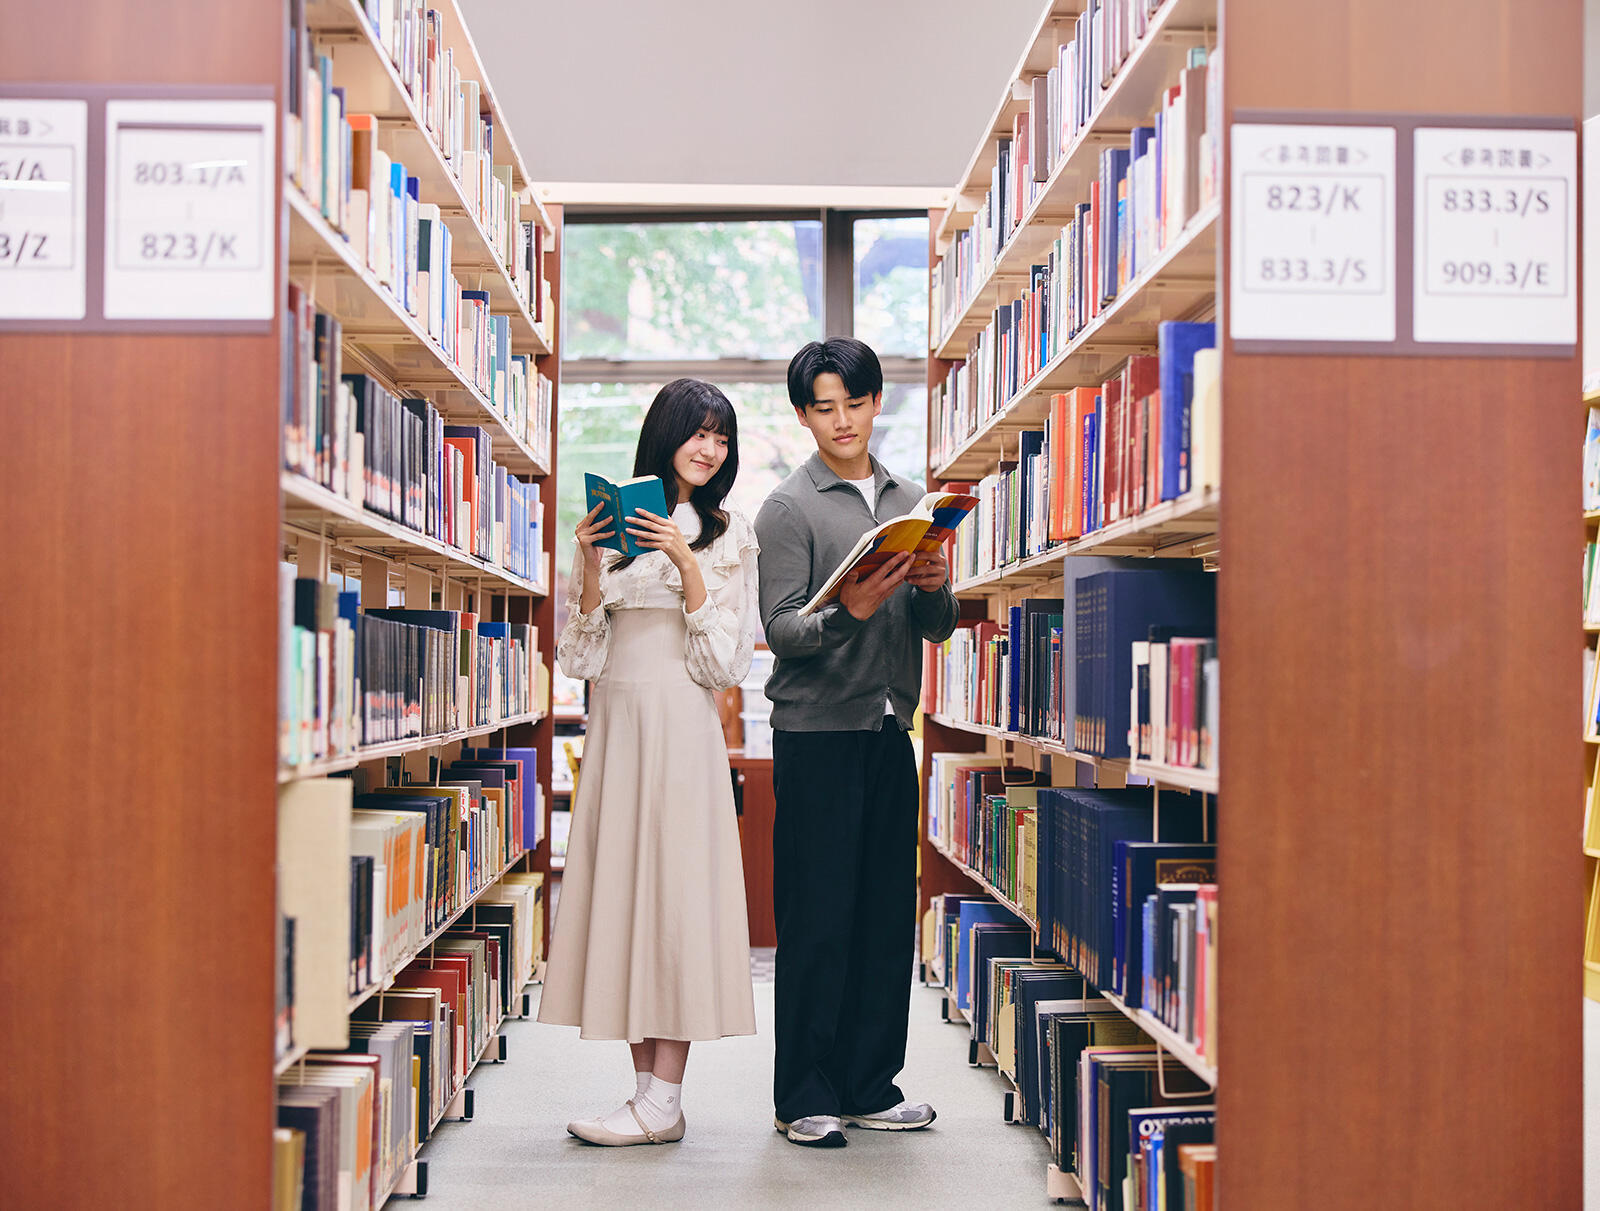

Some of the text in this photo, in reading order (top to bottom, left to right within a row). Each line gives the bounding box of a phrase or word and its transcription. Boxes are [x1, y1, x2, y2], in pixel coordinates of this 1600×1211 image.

[1267, 184, 1360, 215] 823/K
[1444, 188, 1550, 217] 833.3/S
[140, 232, 237, 267] 823/K
[1261, 257, 1368, 286] 833.3/S
[1443, 261, 1550, 289] 909.3/E
